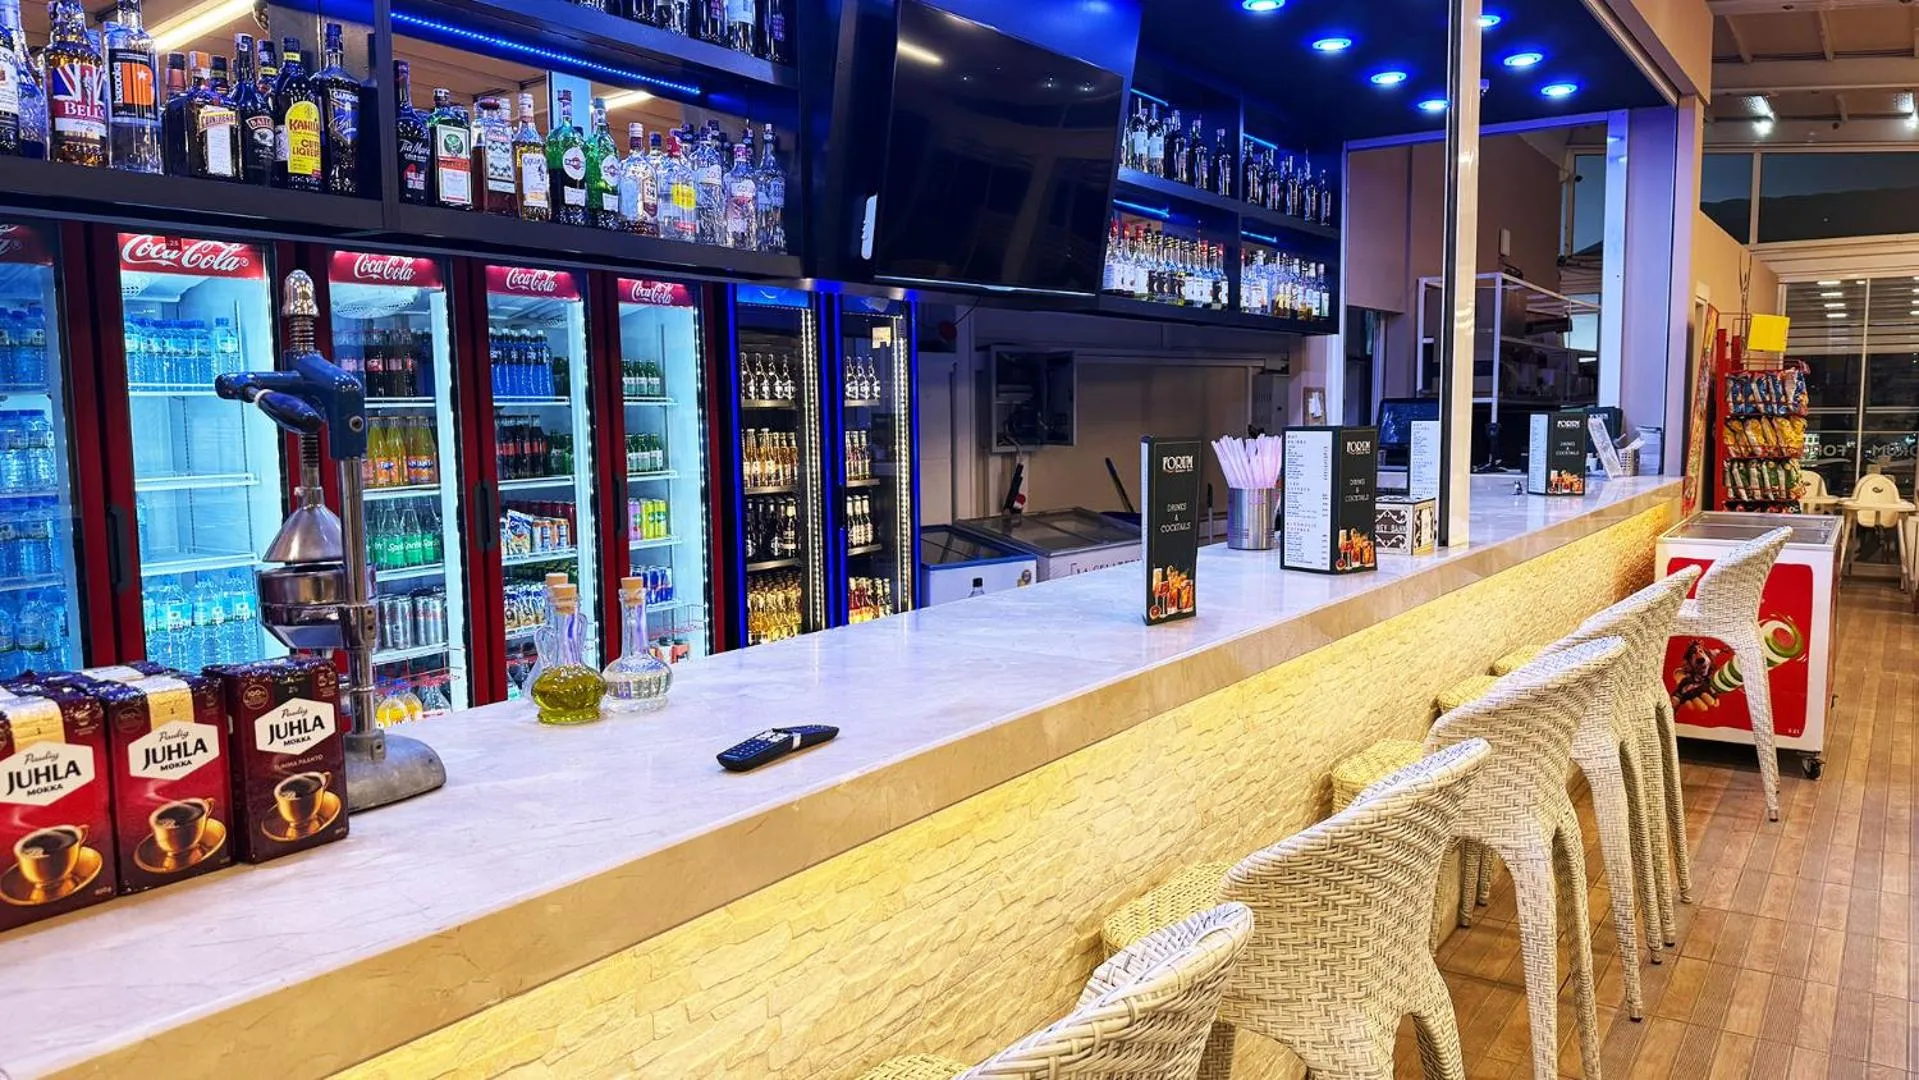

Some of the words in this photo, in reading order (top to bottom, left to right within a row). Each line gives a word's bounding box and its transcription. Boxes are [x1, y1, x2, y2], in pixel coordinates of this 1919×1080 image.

[122, 234, 241, 272] Coca-Cola
[353, 253, 416, 281] Coca-Cola
[506, 267, 557, 292] Coca-Cola
[1162, 455, 1194, 472] FORUM
[267, 715, 325, 745] JUHLA
[283, 735, 312, 747] MOKKA
[143, 737, 208, 771] JUHLA
[160, 760, 192, 772] MOKKA
[6, 760, 82, 796] JUHLA
[27, 783, 63, 796] MOKKA
